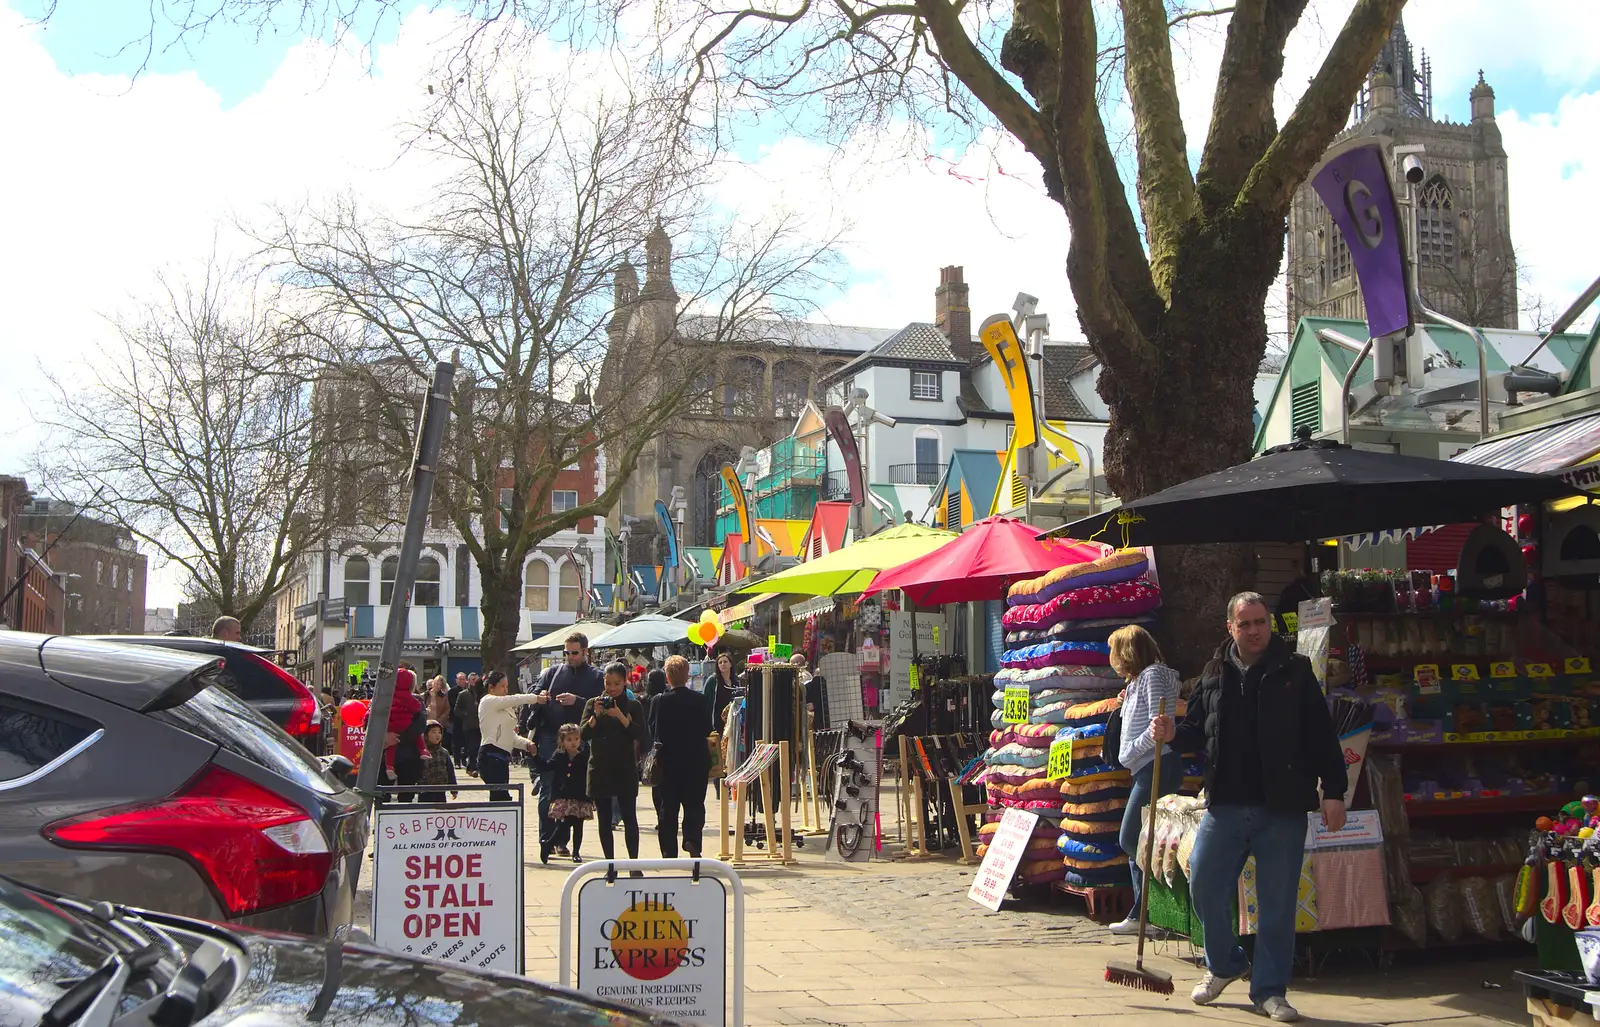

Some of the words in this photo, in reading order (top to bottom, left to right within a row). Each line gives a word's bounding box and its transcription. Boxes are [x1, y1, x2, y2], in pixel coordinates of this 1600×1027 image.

[1343, 179, 1384, 250] G
[995, 339, 1016, 389] F
[903, 619, 934, 631] Nwich
[385, 826, 396, 839] S
[399, 822, 409, 836] &
[412, 819, 422, 832] B
[426, 815, 508, 836] FOOTWEAR
[1014, 813, 1032, 832] Beds
[392, 842, 408, 850] ALL
[451, 840, 497, 848] FOOTWEAR
[404, 853, 483, 880] SHOE
[404, 882, 494, 910] STALL
[624, 889, 676, 912] THE
[403, 911, 481, 939] OPEN
[599, 918, 699, 941] ORIENT
[592, 946, 706, 970] EXPRESS
[596, 985, 638, 997] GENUINE
[640, 983, 702, 995] INGREDIENTS
[656, 996, 697, 1006] RECIPES
